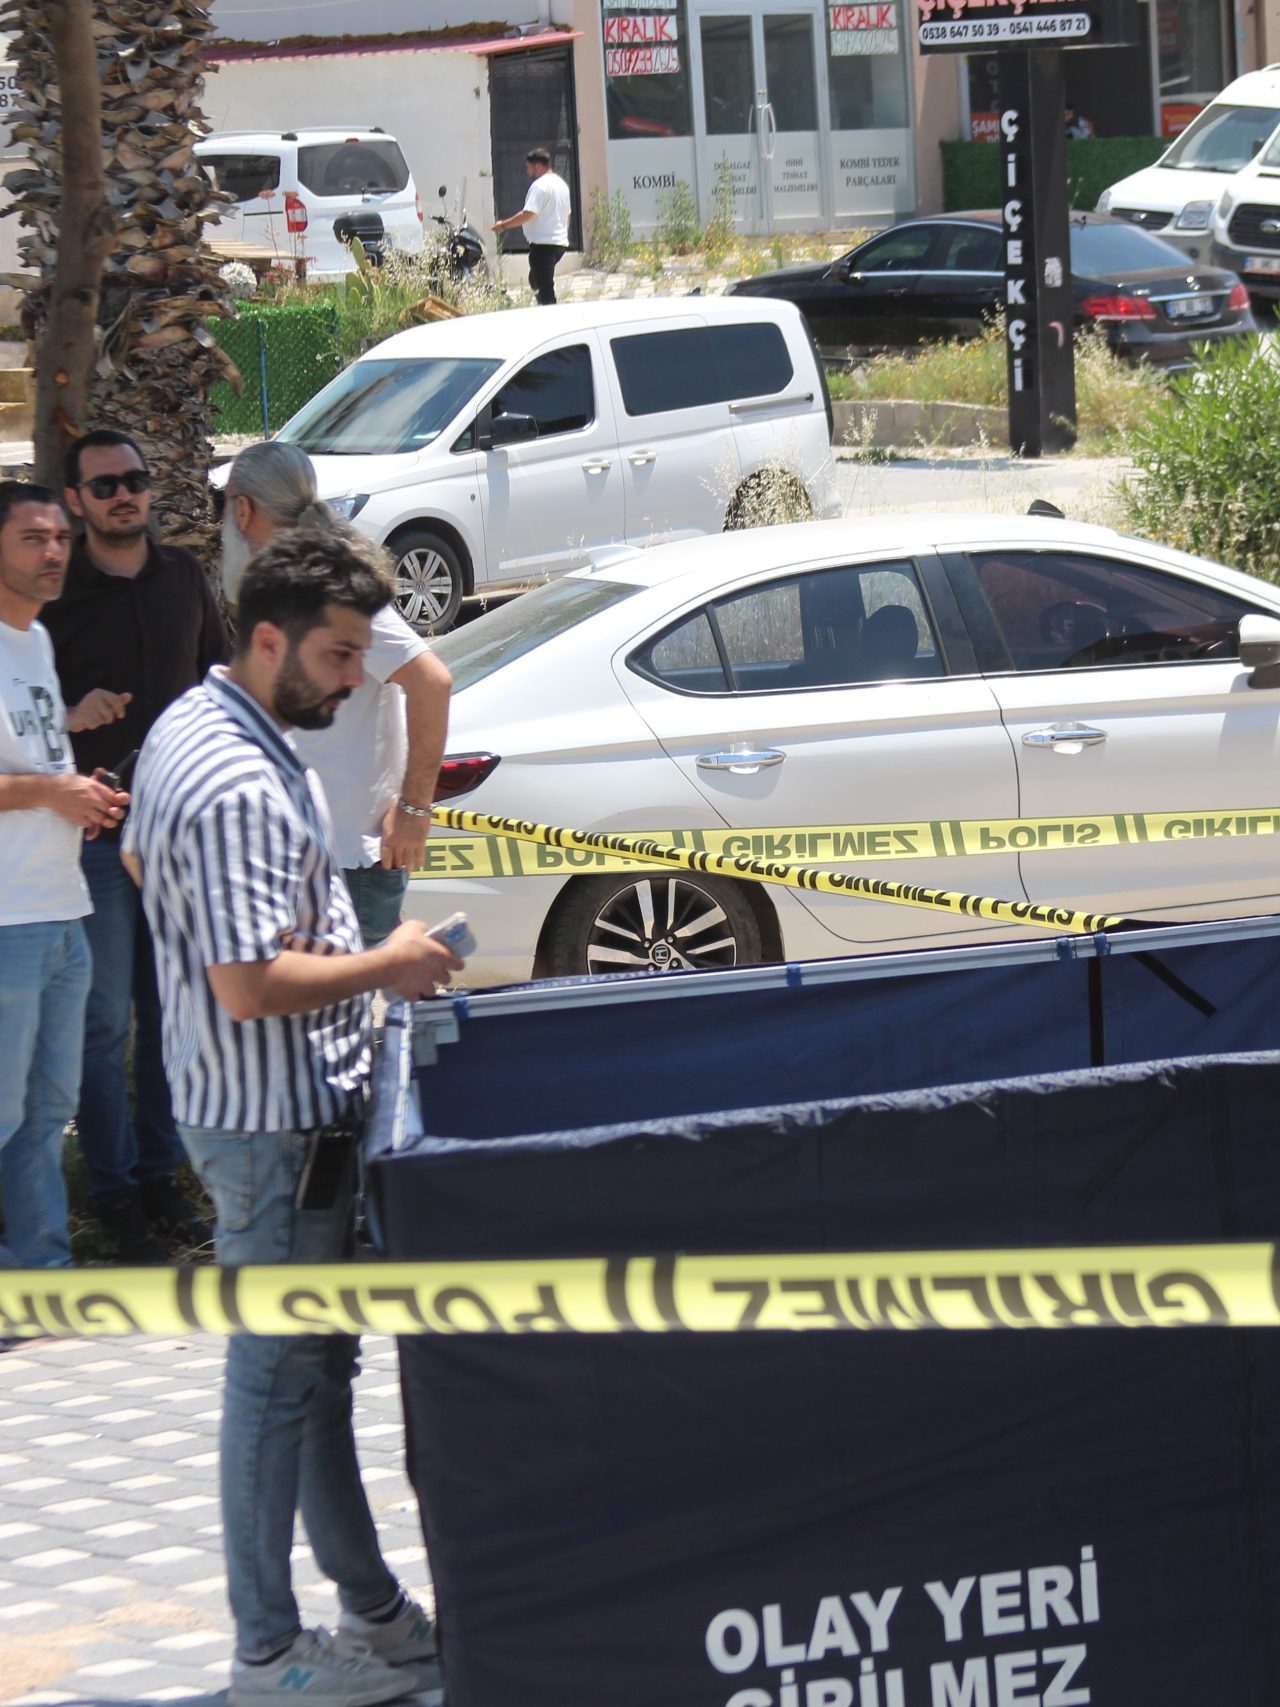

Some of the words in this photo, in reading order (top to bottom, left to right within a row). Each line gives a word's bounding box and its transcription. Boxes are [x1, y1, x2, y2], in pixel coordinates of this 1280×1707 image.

[604, 16, 673, 42] KIRALIK
[832, 4, 894, 31] KIRALIK
[922, 25, 947, 40] 0538
[950, 24, 968, 38] 647
[971, 24, 984, 37] 50
[987, 23, 999, 36] 39
[1009, 21, 1033, 34] 0541
[1036, 20, 1056, 33] 446
[1060, 19, 1072, 31] 87
[1075, 18, 1086, 30] 21
[872, 156, 900, 168] YEDEK
[632, 172, 676, 189] KOMBİ
[704, 1586, 903, 1674] OLAY
[923, 1544, 1100, 1642] YERİ
